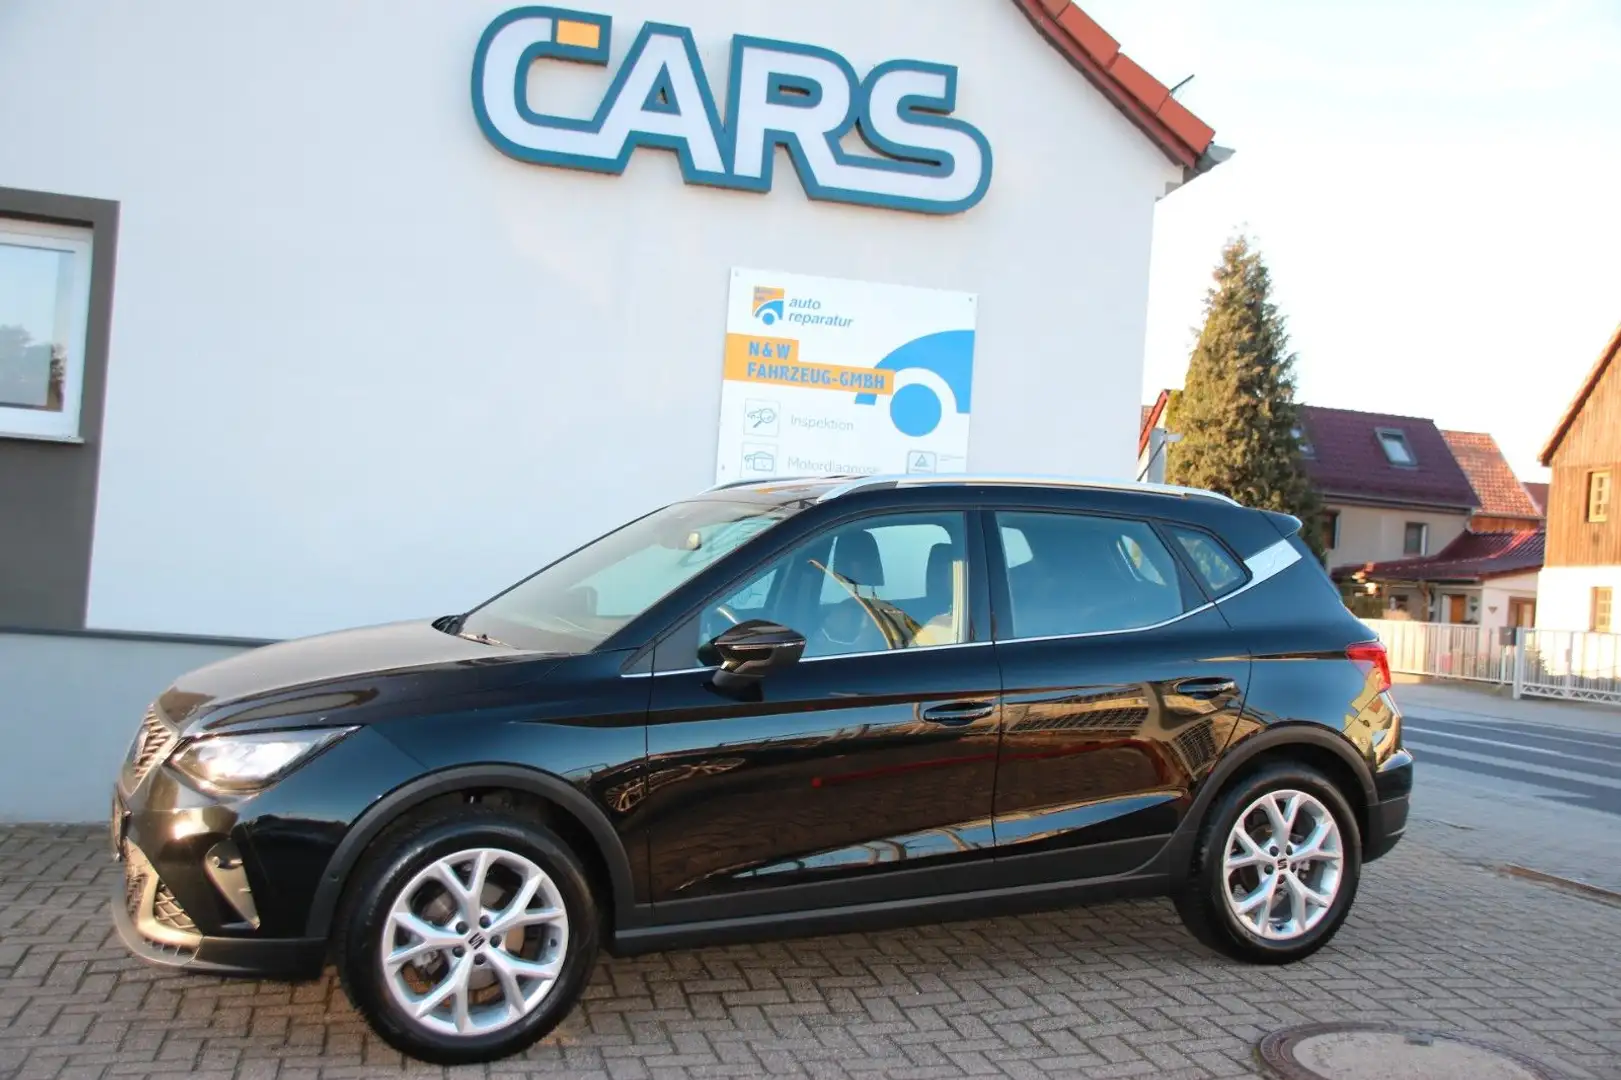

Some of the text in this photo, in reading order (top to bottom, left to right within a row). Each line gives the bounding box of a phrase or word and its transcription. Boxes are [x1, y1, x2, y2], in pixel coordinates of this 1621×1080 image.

[472, 5, 993, 215] CARS
[788, 297, 821, 311] auto
[788, 311, 854, 329] reparatur
[748, 341, 792, 360] N & W
[747, 361, 886, 389] FAHRZEUG-GMBH
[790, 414, 854, 431] Inspektion
